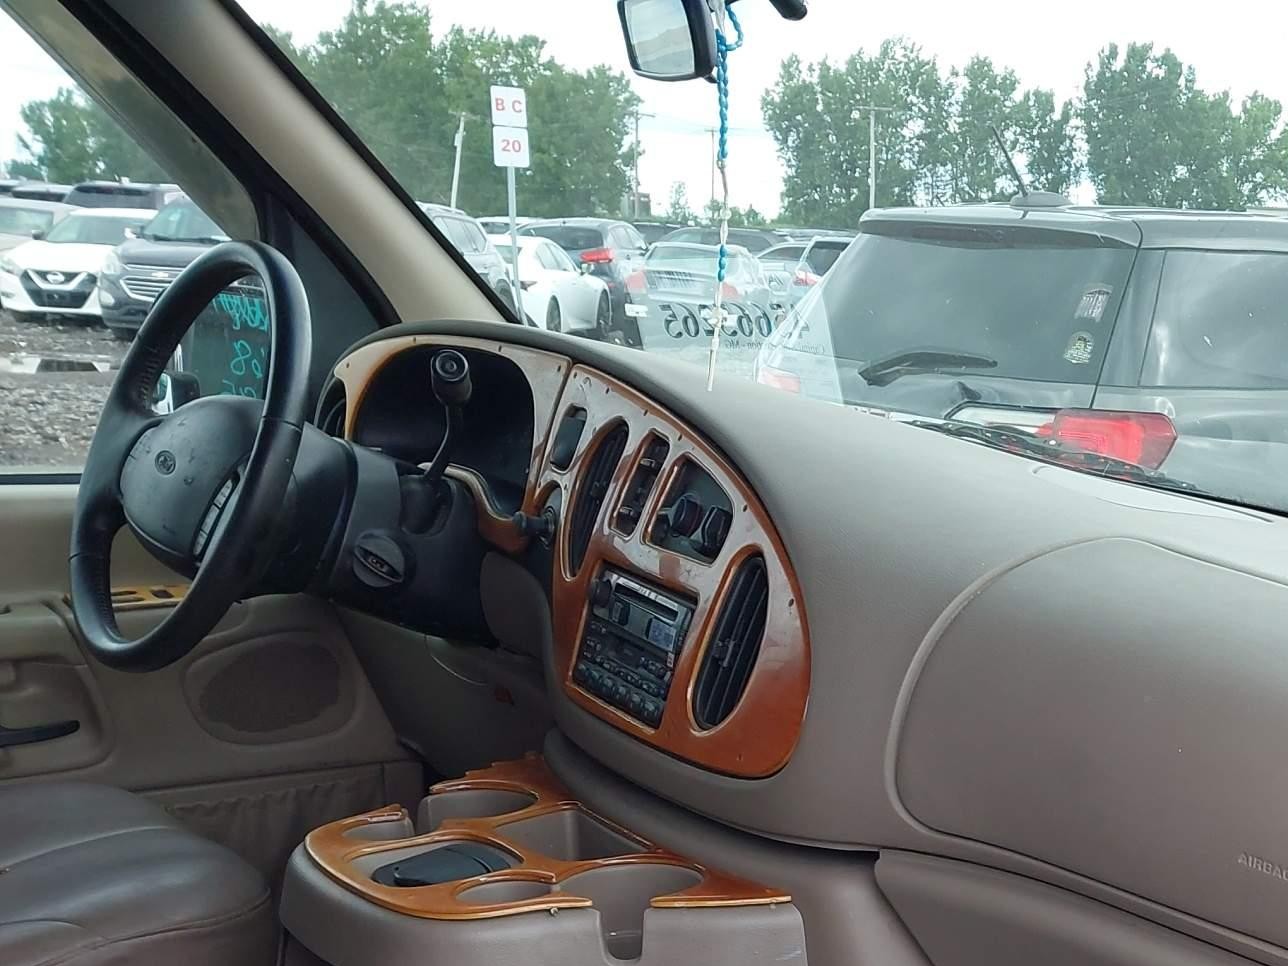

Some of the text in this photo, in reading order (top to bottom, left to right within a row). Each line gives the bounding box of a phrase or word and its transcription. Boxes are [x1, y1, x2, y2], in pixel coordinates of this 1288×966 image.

[495, 98, 523, 113] B C
[501, 139, 522, 153] 20
